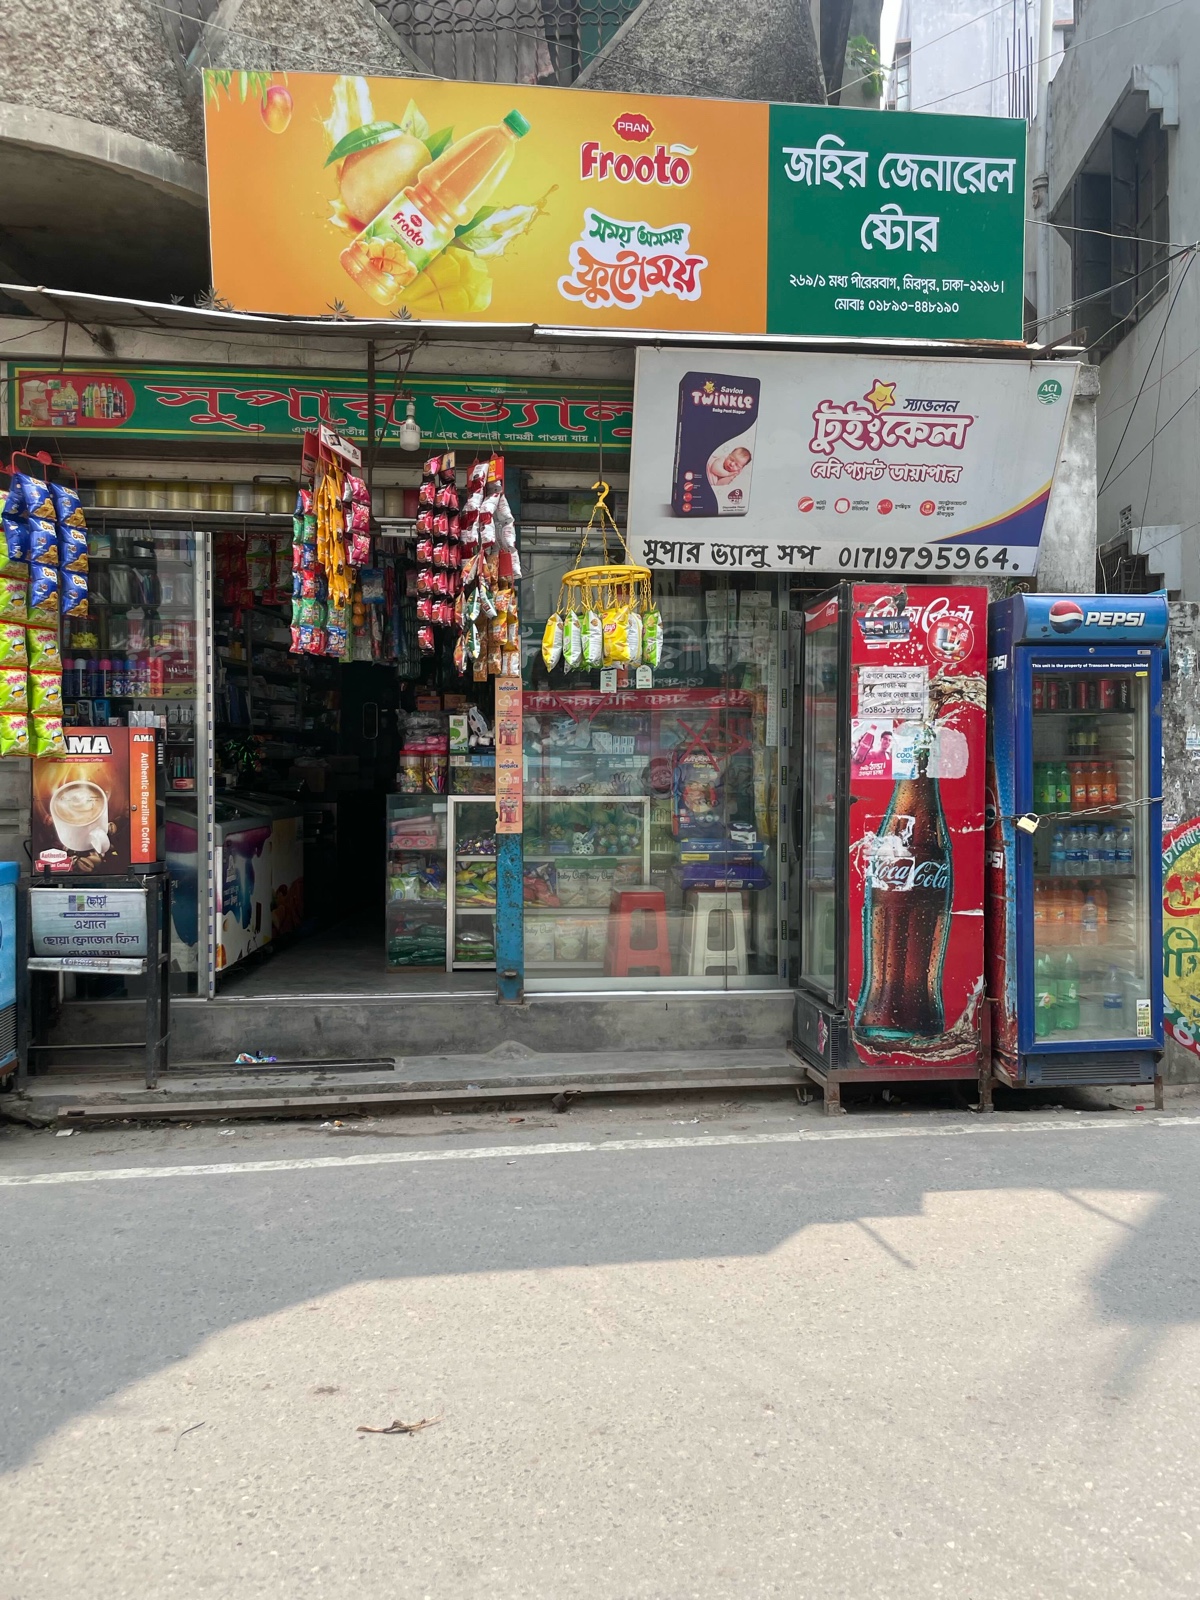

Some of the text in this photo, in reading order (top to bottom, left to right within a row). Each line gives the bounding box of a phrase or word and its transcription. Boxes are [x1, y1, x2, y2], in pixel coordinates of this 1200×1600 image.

[617, 121, 650, 133] PRAN
[580, 141, 692, 187] Frooto
[782, 134, 1016, 194] জহির জেনারেল
[392, 211, 424, 246] Frooto
[589, 213, 635, 248] সময়
[789, 273, 826, 287] ২৬৯/১
[828, 274, 849, 288] মধ্য
[850, 271, 900, 291] পীরেরবাগ,
[902, 273, 940, 295] মিরপুর,
[868, 301, 960, 313] ০১৮৯৩-৪৪৮১৯০
[720, 386, 744, 395] Savlon
[1041, 383, 1058, 393] ACI
[902, 398, 960, 413] স্যাভলন
[811, 457, 844, 479] বেবি
[888, 464, 963, 484] ডায়াপার
[642, 538, 822, 569] সুপার ভ্যালু সপ
[1084, 611, 1146, 628] PEPSI
[140, 752, 151, 853] Authentic Brazilian Coffee
[914, 861, 949, 888] Cola
[73, 920, 106, 929] এখানে
[114, 933, 139, 945] ফিশ
